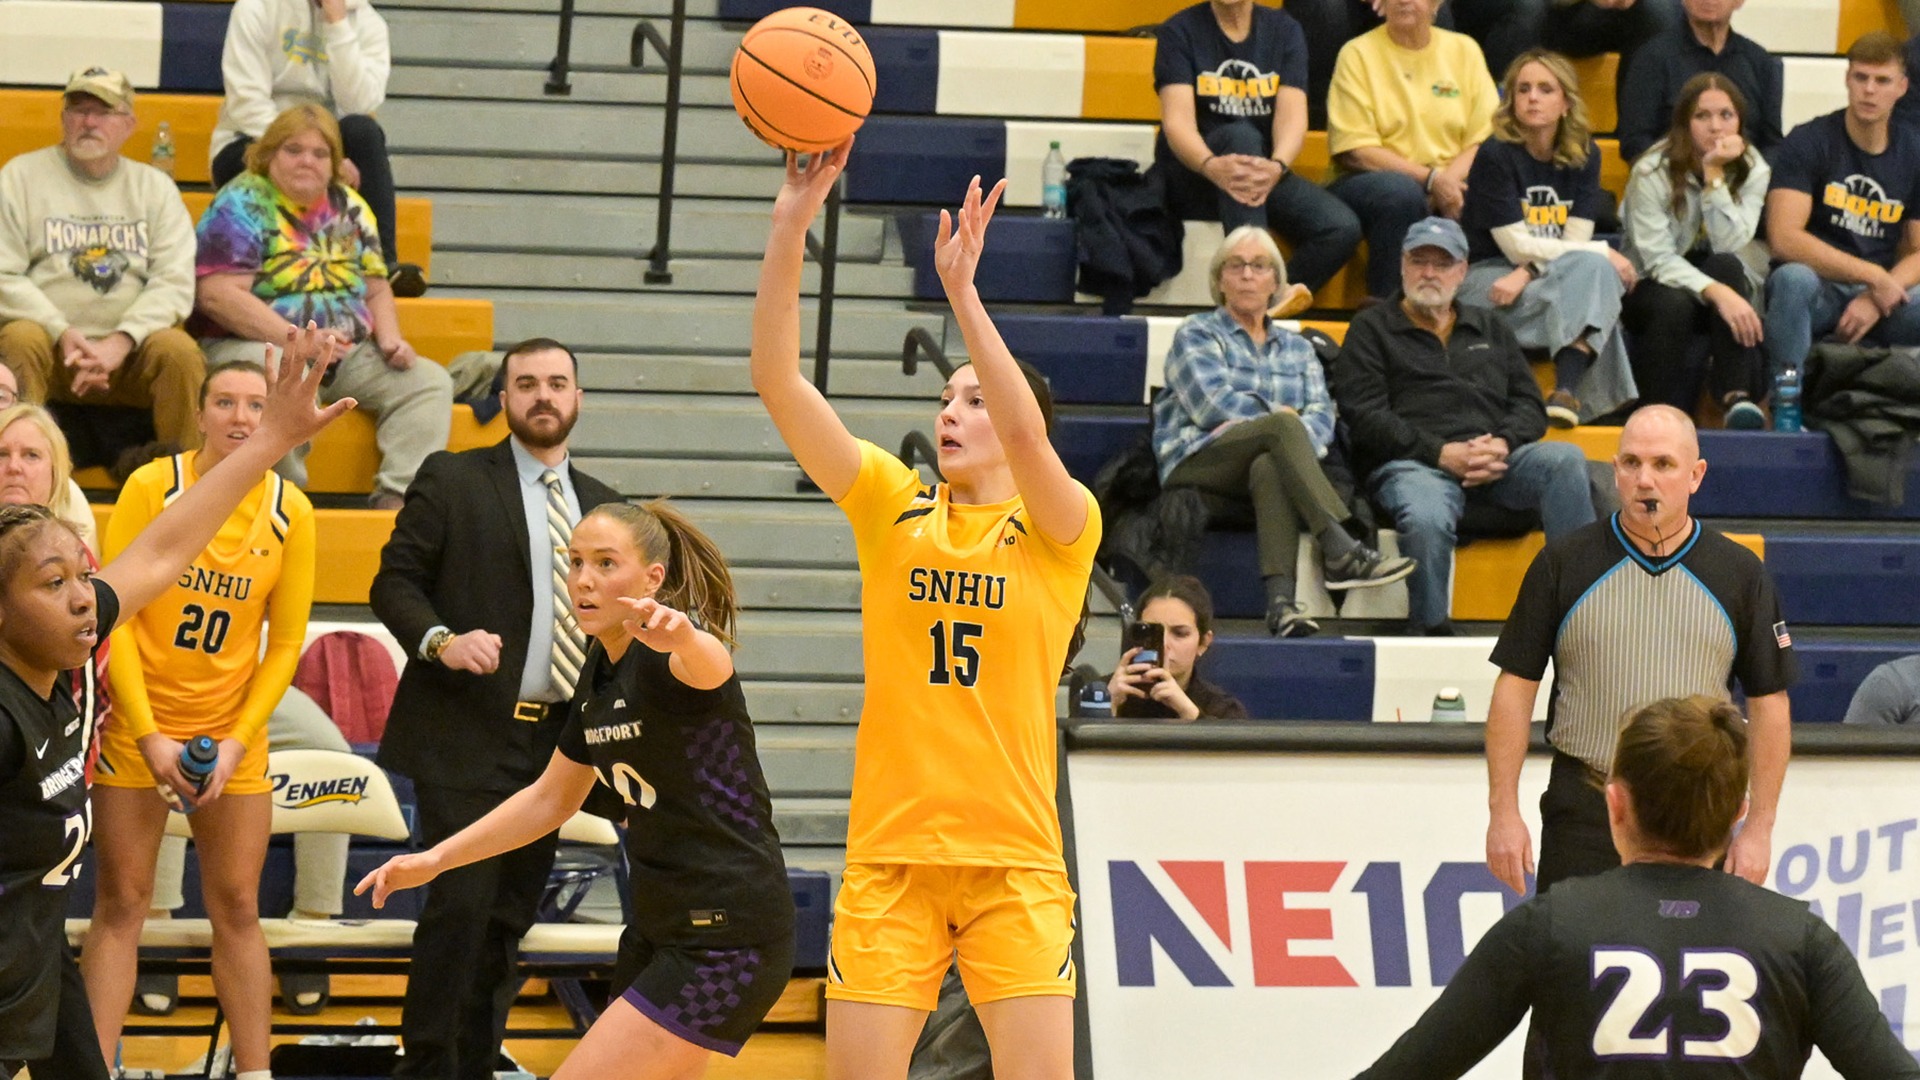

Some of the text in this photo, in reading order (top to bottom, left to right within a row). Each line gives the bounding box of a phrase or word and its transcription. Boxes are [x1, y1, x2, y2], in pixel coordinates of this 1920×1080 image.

[808, 13, 861, 46] EVO
[44, 218, 149, 259] MONARCHS
[908, 567, 1007, 610] SNHU
[174, 603, 232, 654] 20
[928, 619, 983, 688] 15
[270, 774, 369, 801] PENMEN
[1776, 818, 1918, 896] OUT
[714, 913, 723, 922] M
[1108, 860, 1539, 987] NE10
[1590, 944, 1764, 1064] 23
